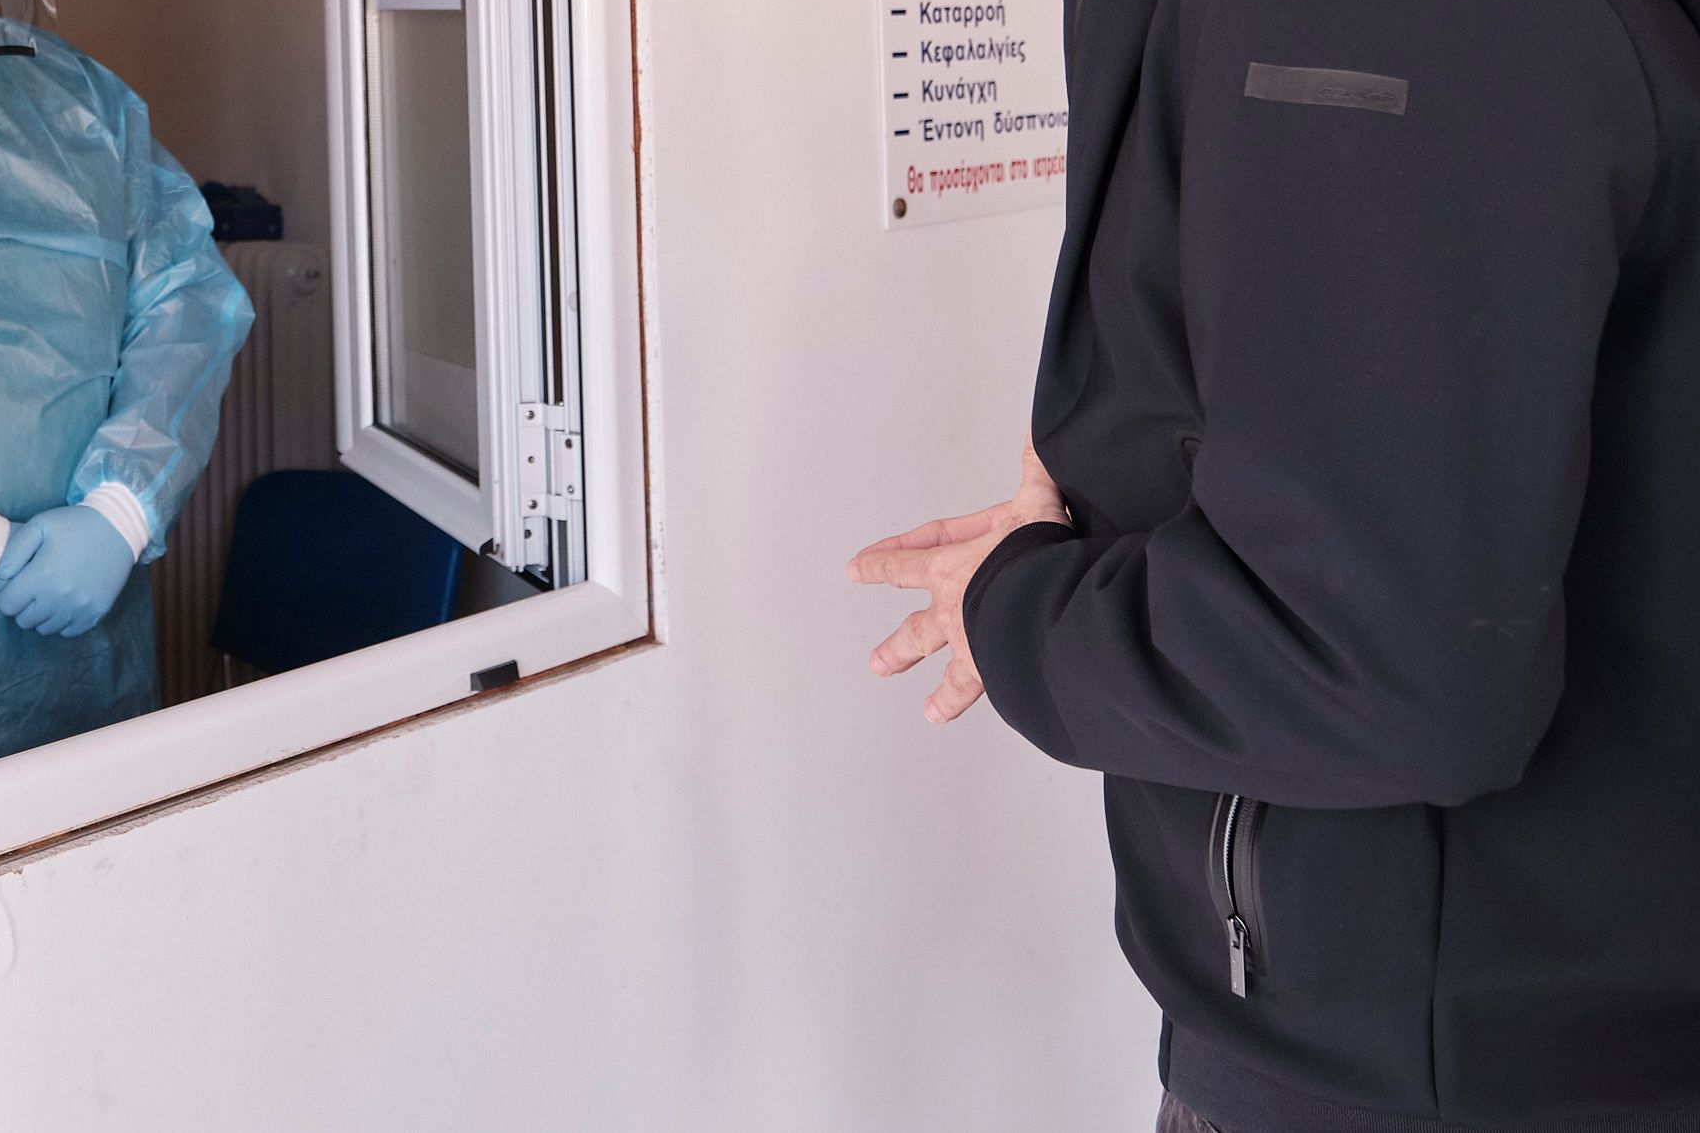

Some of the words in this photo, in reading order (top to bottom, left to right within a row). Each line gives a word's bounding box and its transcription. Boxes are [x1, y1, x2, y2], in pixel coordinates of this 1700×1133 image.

[920, 35, 1027, 68] Κεφαλαλγίες
[921, 75, 999, 105] Κυνάγχη
[919, 117, 985, 143] Έντονη
